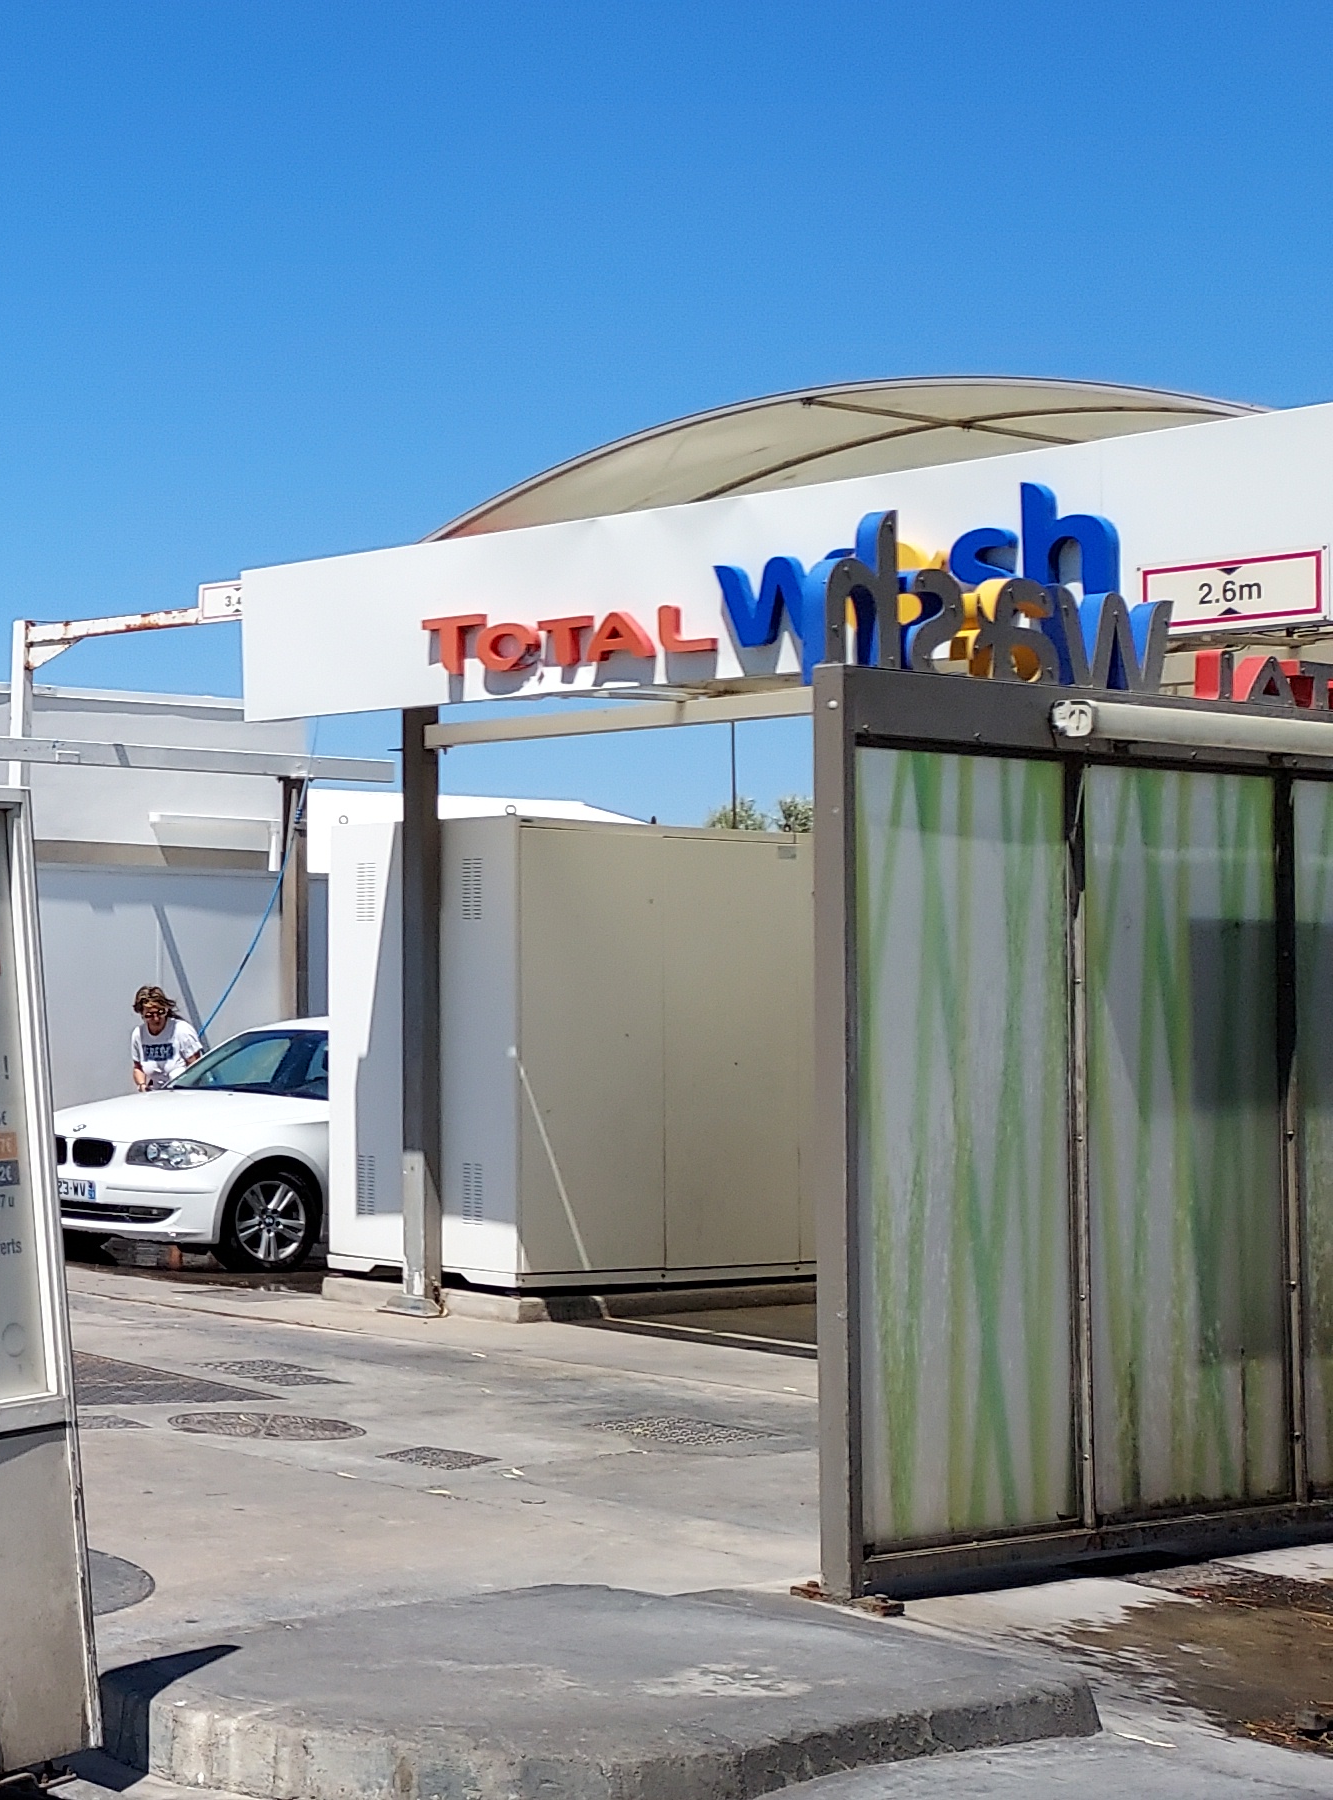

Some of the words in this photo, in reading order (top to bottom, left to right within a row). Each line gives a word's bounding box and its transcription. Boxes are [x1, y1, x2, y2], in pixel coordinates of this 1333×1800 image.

[1198, 580, 1262, 606] 2.6m
[422, 605, 719, 675] TOTAL
[8, 1196, 15, 1207] u
